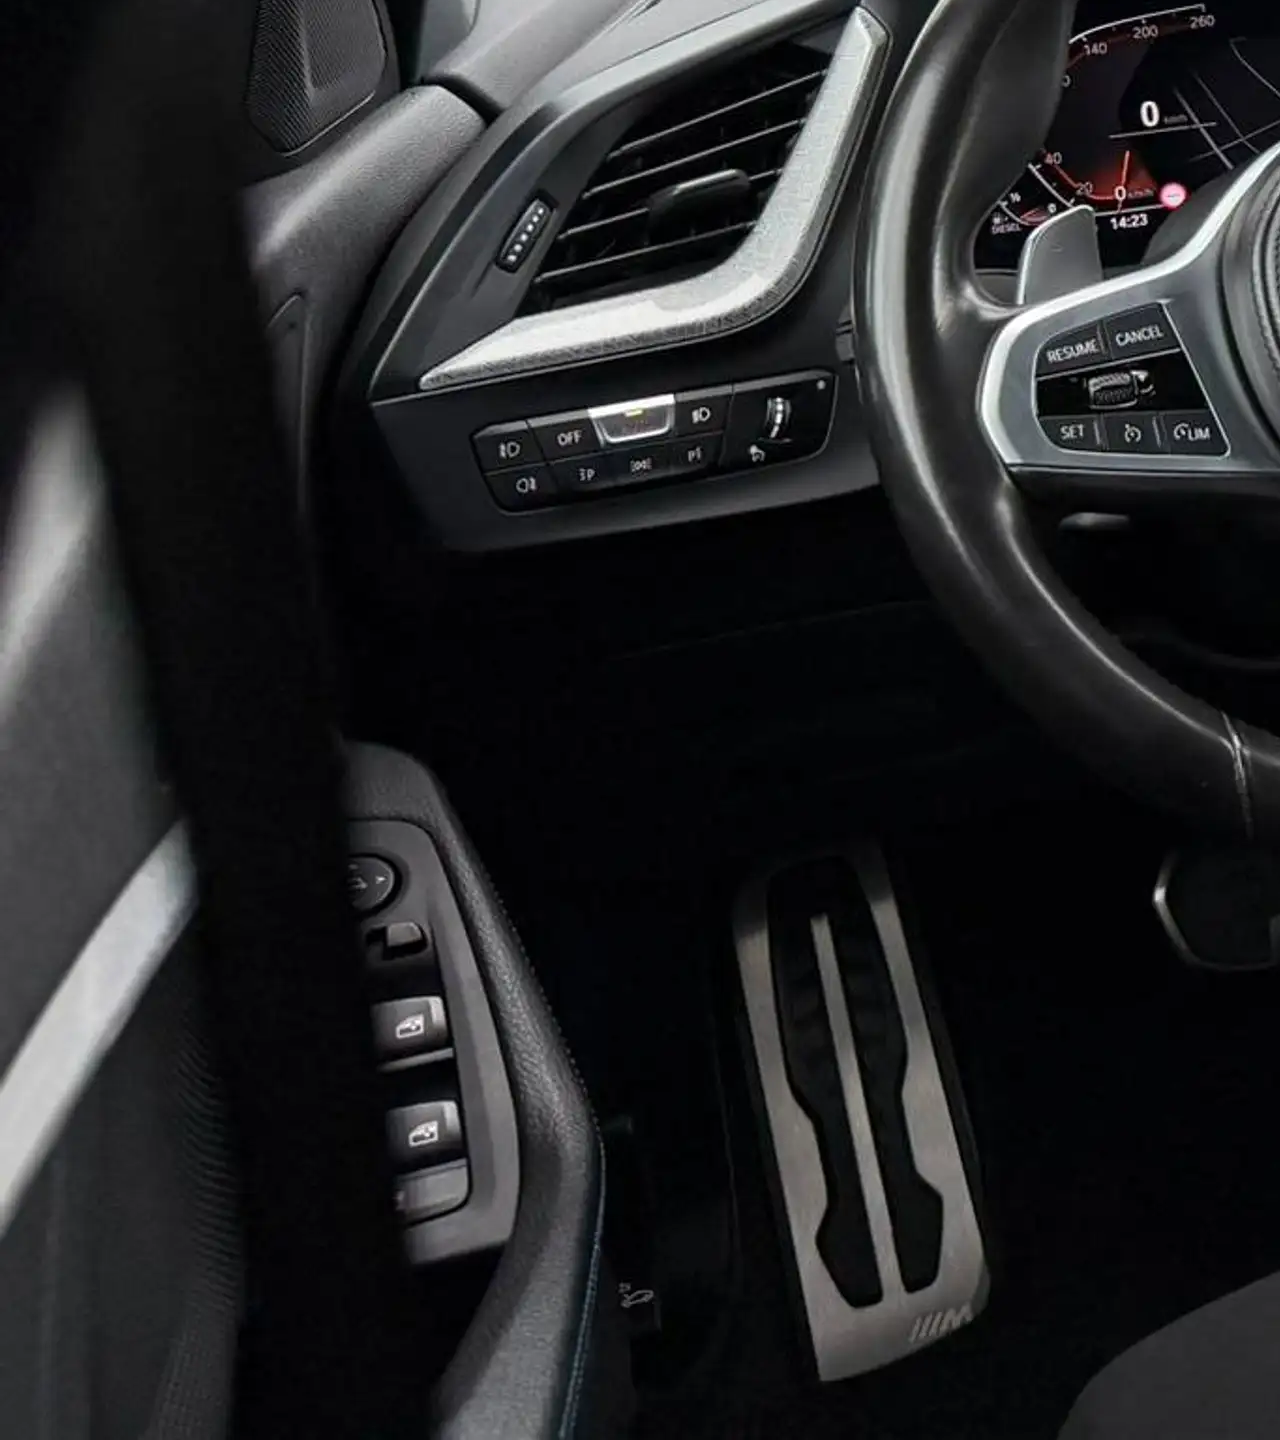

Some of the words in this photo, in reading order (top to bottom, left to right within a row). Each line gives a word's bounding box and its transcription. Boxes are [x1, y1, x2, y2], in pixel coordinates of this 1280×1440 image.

[1189, 15, 1216, 29] 260
[1132, 25, 1159, 39] 200
[1084, 43, 1108, 56] 140
[1140, 100, 1160, 127] 0
[1044, 151, 1063, 166] 40
[1075, 181, 1094, 196] 20
[1114, 185, 1127, 200] 0
[1110, 214, 1148, 230] 14:23
[1115, 325, 1164, 347] CANCEL
[1046, 338, 1100, 363] RESUME
[557, 429, 582, 447] OFF
[1060, 423, 1085, 440] SET
